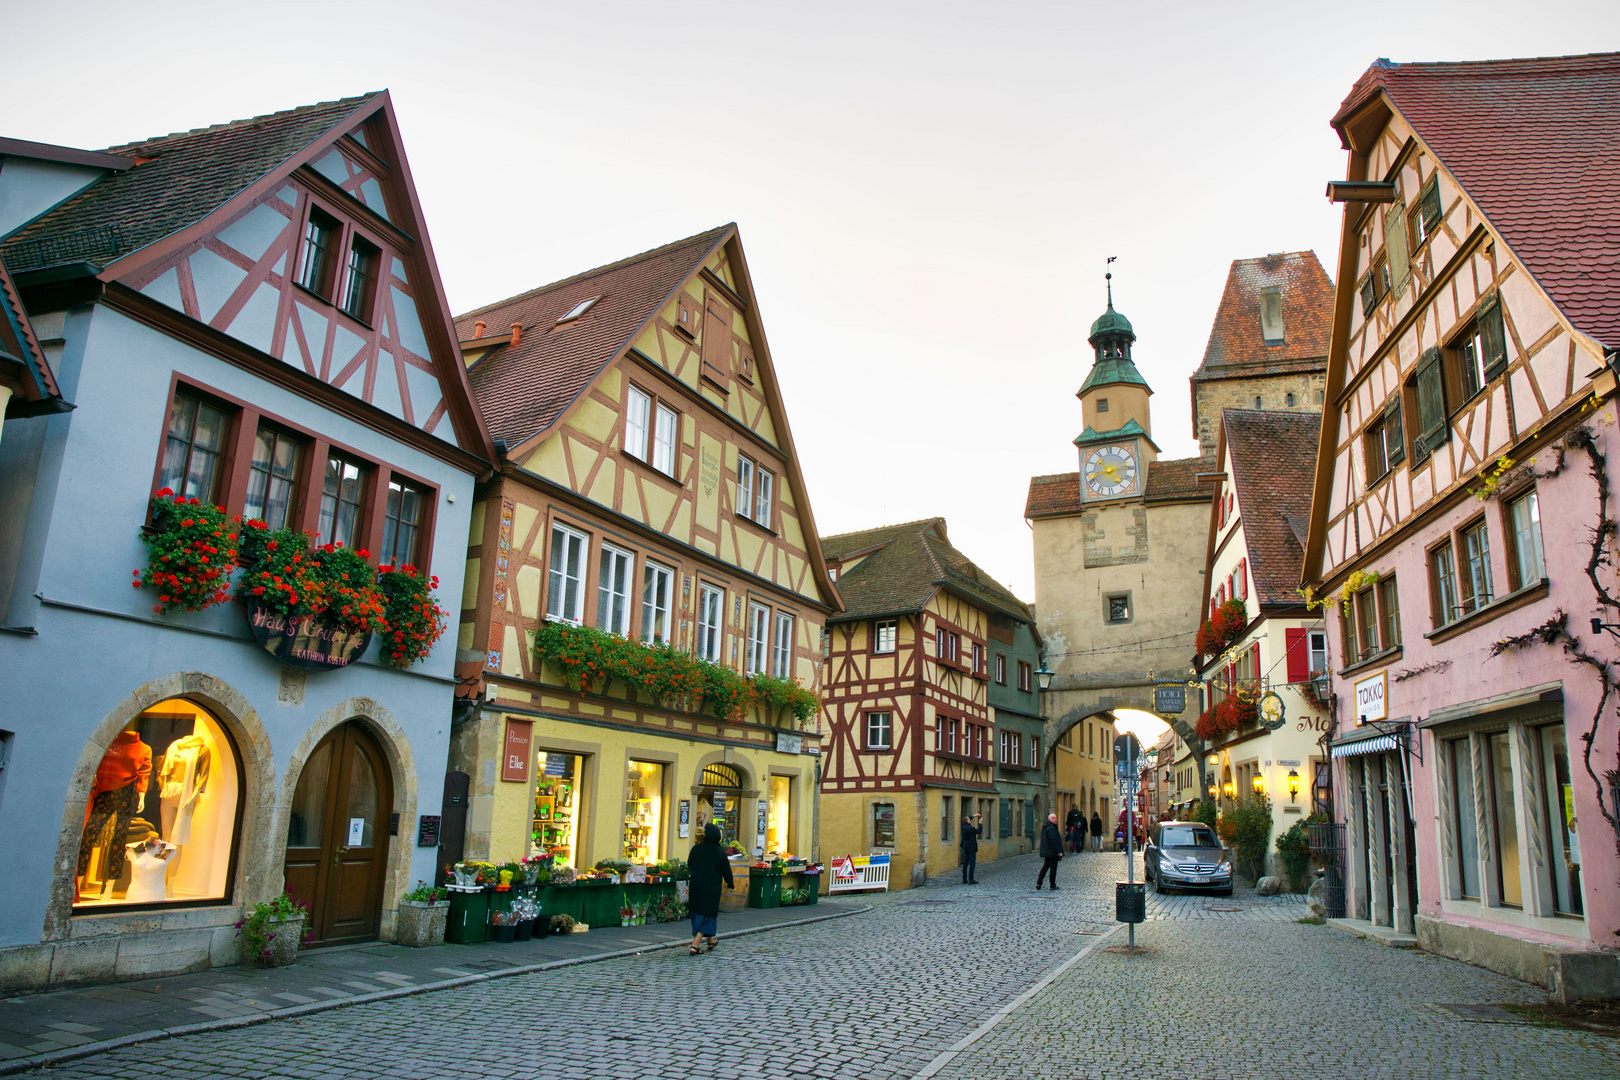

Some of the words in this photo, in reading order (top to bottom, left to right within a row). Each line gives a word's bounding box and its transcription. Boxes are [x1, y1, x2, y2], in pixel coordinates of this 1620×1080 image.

[296, 649, 325, 663] KATHRIN
[509, 730, 528, 744] Pension
[509, 755, 524, 769] Elke
